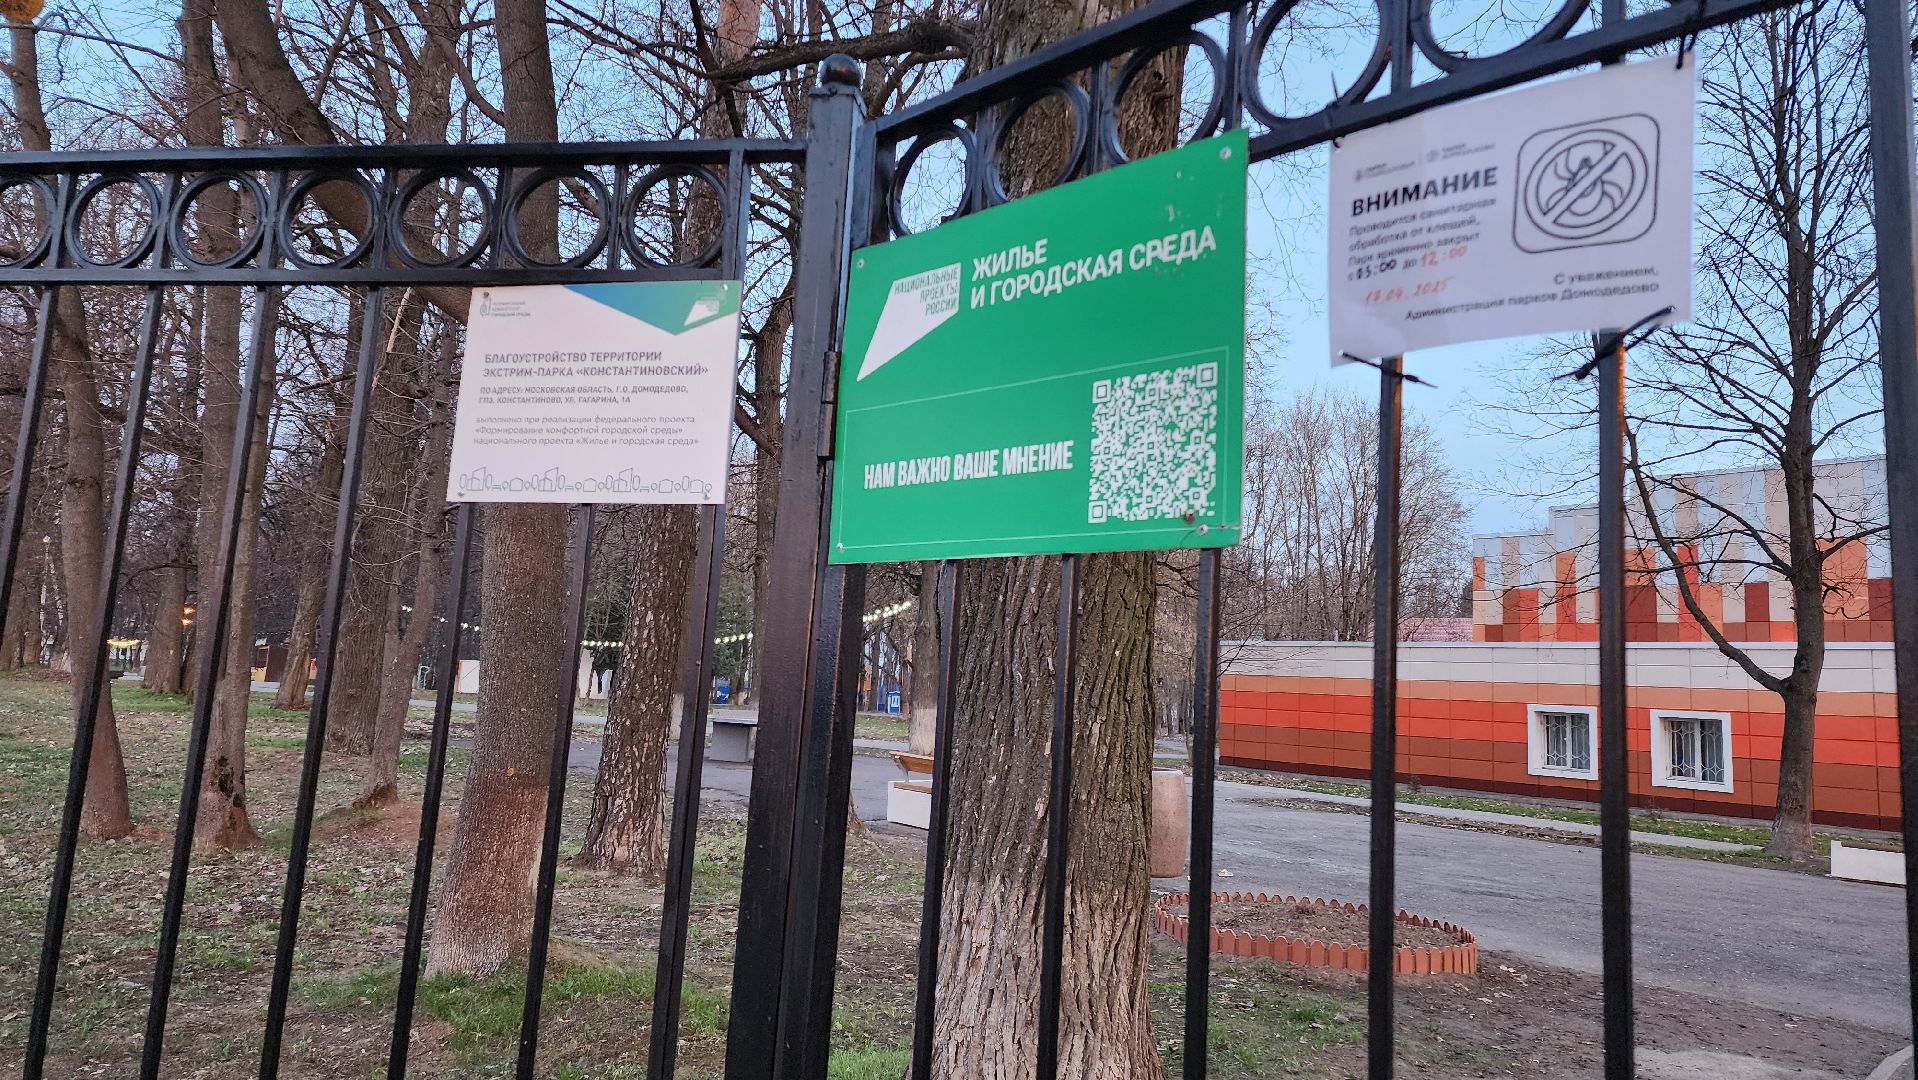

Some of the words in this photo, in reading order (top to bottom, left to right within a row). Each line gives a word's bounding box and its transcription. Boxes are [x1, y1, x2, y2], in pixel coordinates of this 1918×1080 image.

[1352, 165, 1498, 217] ВНИМАНИЕ
[970, 283, 985, 310] И
[990, 248, 1124, 306] ГОРОДСКАЯ
[1128, 225, 1217, 271] СРЕДА
[971, 238, 1049, 281] ЖИЛЬЕ
[1403, 258, 1418, 270] до
[894, 265, 959, 296] НАЦИОНАЛЬНЫЕ
[1553, 273, 1564, 285] С
[920, 281, 958, 303] ПРОЕКТЫ
[925, 297, 957, 317] РОССИИ
[1405, 298, 1505, 321] Администрация
[1560, 281, 1659, 301] Домодедово
[484, 350, 587, 363] БЛАГОУСТРОЙСТВО
[589, 351, 662, 362] ТЕРРИТОРИИ
[482, 366, 574, 378] ЭКСТРИМ-ПАРКА
[576, 362, 709, 377] «КОНСТАНТИНОВСКИЙ»
[524, 386, 576, 394] МОСКОВСКАЯ
[577, 385, 614, 394] ОБЛАСТЬ,
[631, 385, 688, 394] ДОМОДЕДОВО,
[497, 396, 563, 404] КОНСТАНТИНОВО,
[578, 396, 620, 404] ГАГАРИНА,
[594, 415, 657, 424] федерального
[601, 426, 648, 435] городской
[538, 438, 574, 446] проекта
[619, 438, 665, 446] городская
[864, 461, 896, 490] НАМ
[897, 455, 951, 487] ВАЖНО
[953, 449, 1000, 481] ВАШЕ
[1002, 440, 1074, 476] МНЕНИЕ
